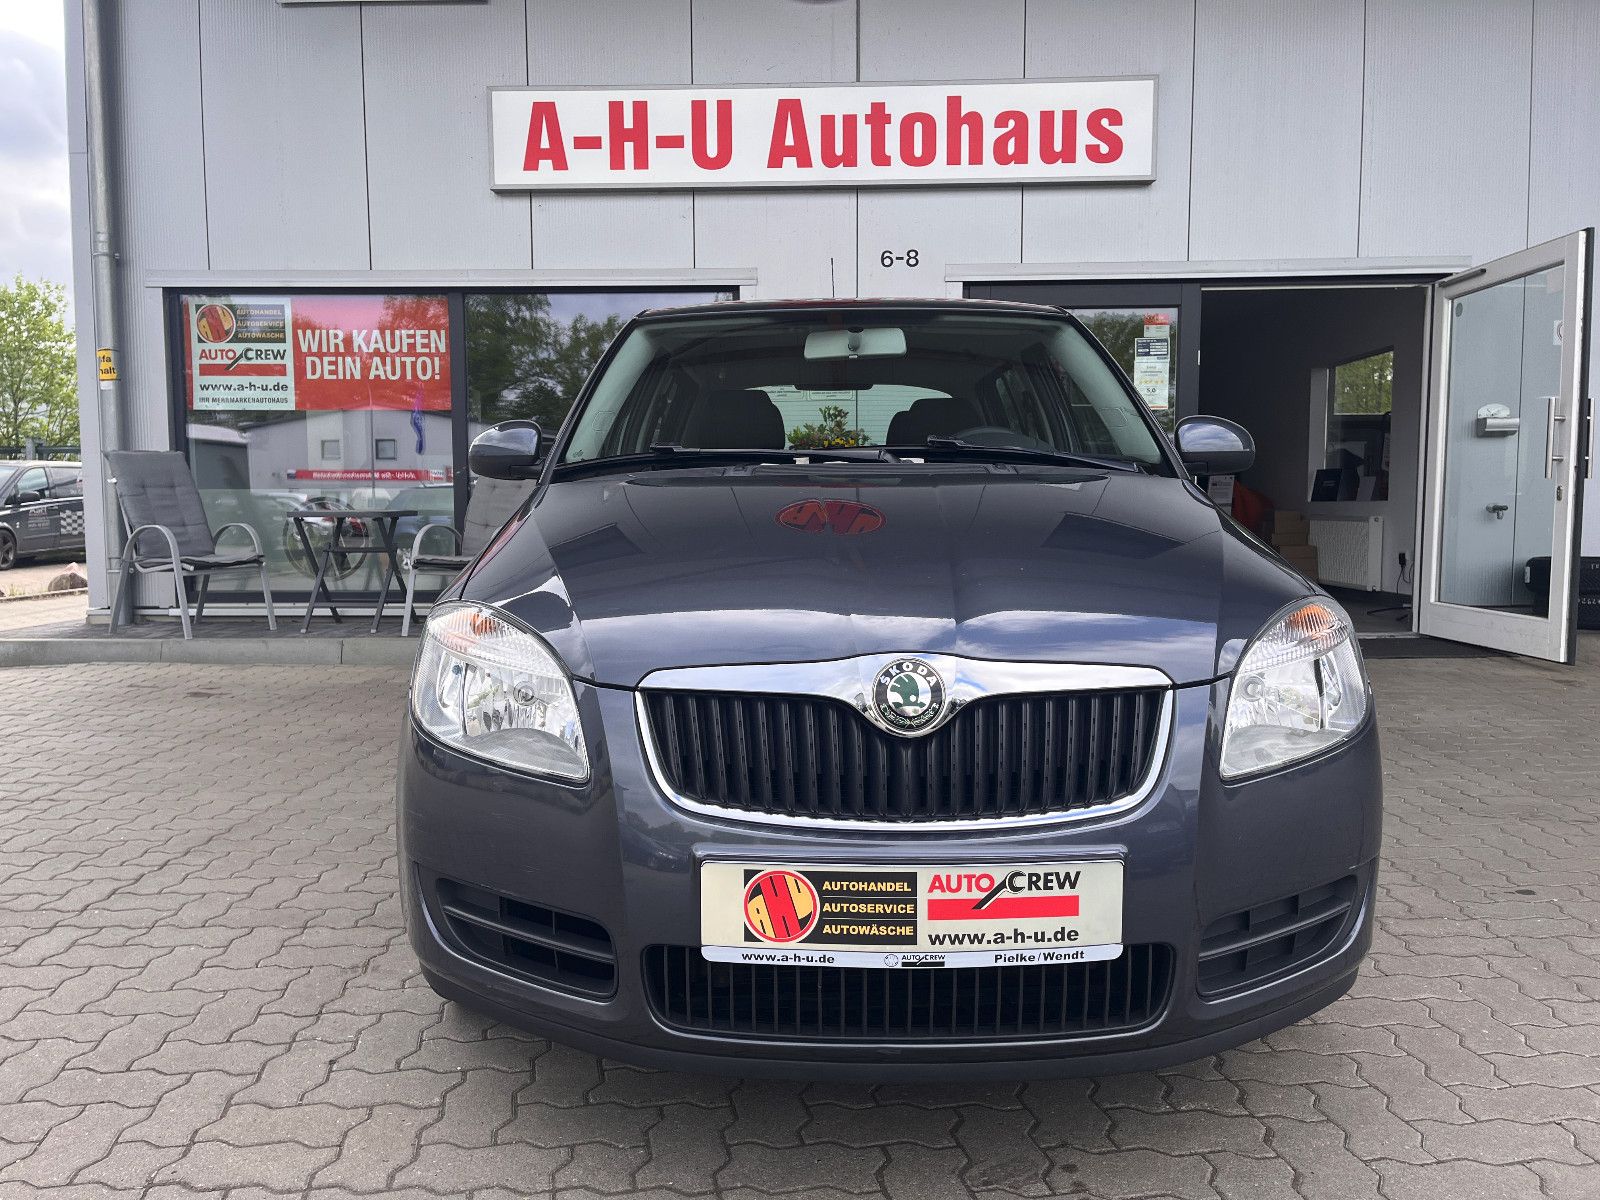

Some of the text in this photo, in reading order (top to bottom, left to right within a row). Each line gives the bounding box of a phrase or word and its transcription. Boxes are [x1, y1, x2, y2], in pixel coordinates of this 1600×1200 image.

[523, 96, 1124, 172] A-H-U Autohaus
[881, 249, 919, 267] 6-8
[297, 329, 447, 353] WIR KAUFEN
[305, 356, 440, 381] DEIN AUTO!
[199, 382, 289, 392] www.a-h-u.de
[822, 881, 912, 892] AUTOHANDEL
[822, 903, 915, 914] AUTOSERVICE
[822, 924, 914, 936] AUTOWÄSCHE
[928, 926, 1079, 946] www.a-h-u.de
[742, 953, 834, 963] www.a-h-u.de
